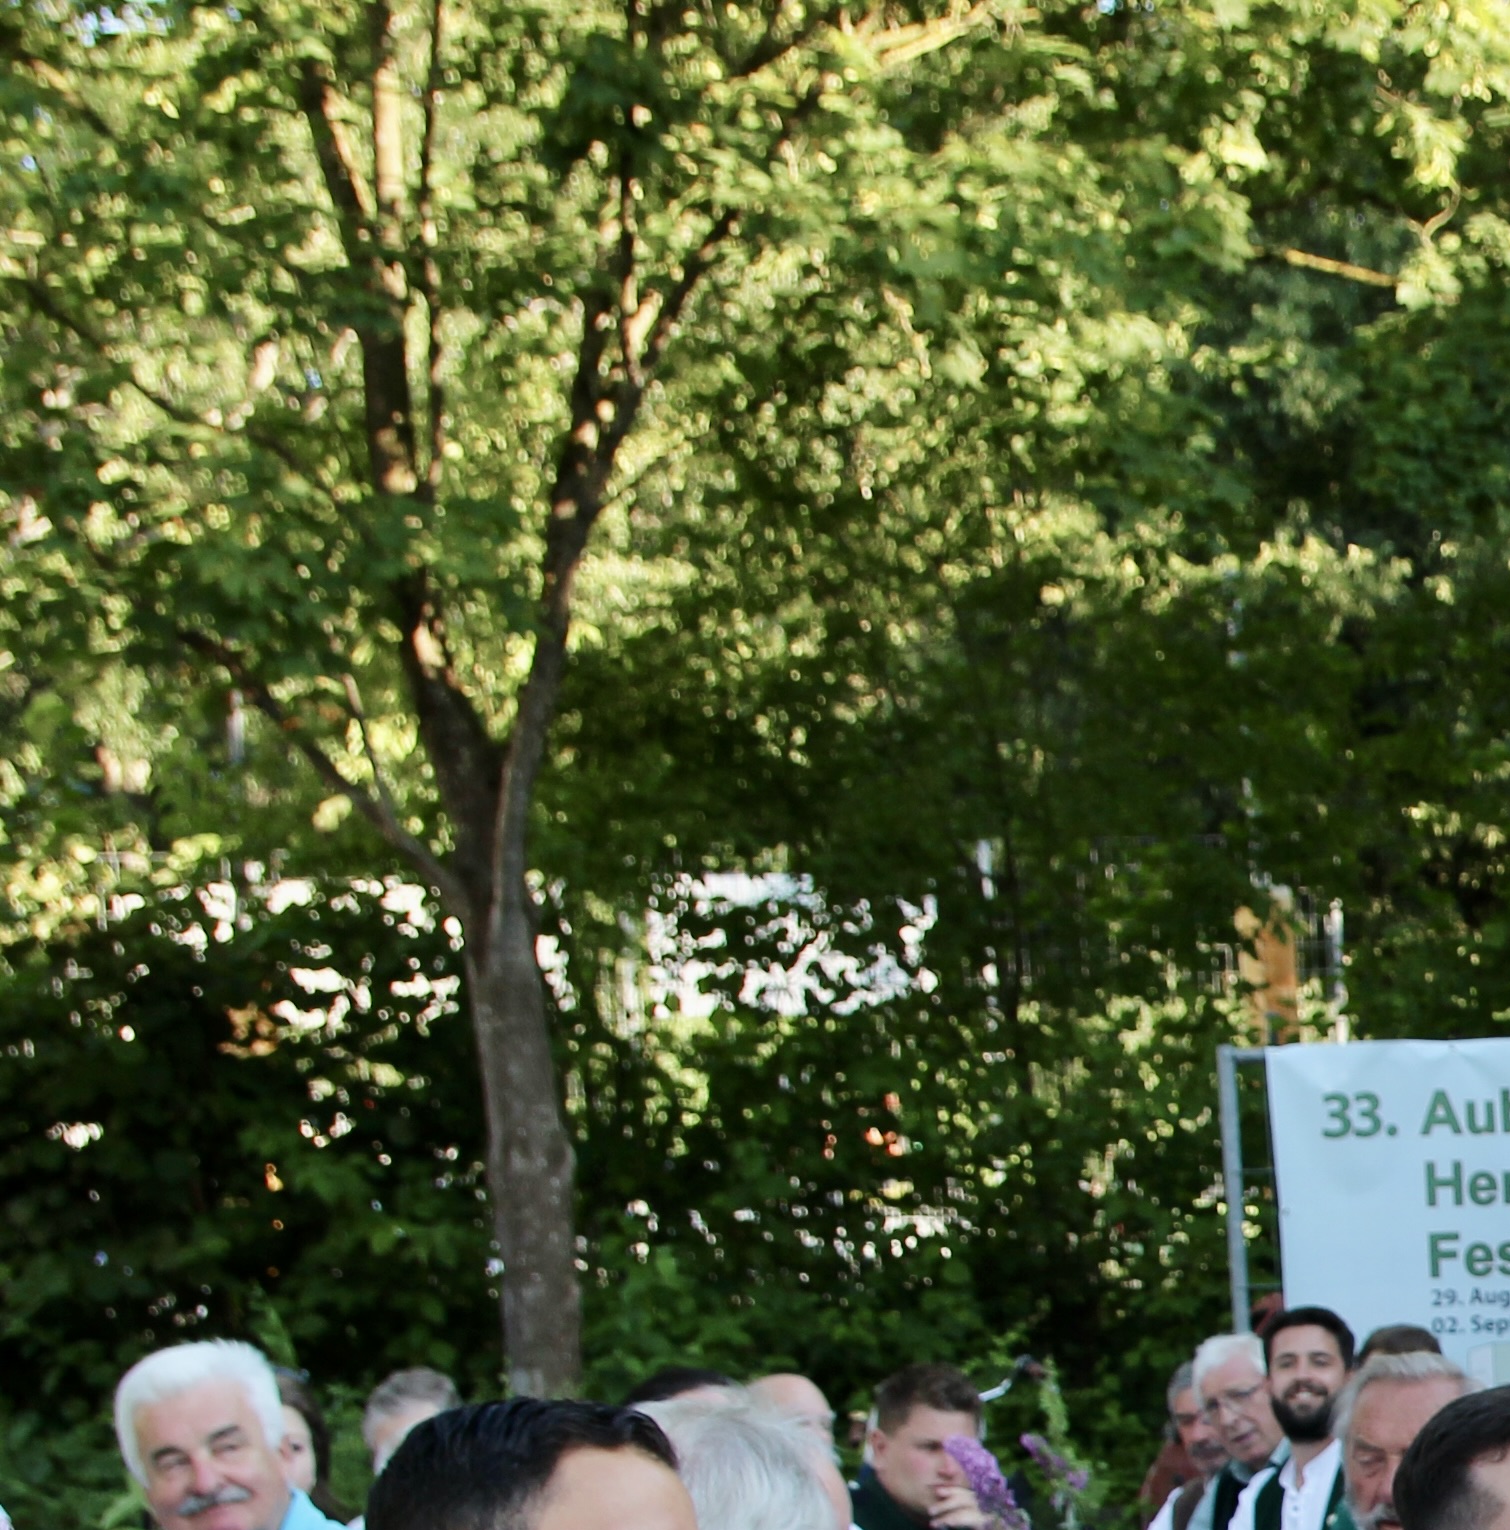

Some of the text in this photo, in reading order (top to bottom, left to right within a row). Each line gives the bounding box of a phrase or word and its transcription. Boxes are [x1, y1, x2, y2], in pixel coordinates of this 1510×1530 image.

[1322, 1092, 1398, 1138] 33.
[1431, 1288, 1466, 1306] 29.
[1431, 1318, 1466, 1334] 02.
